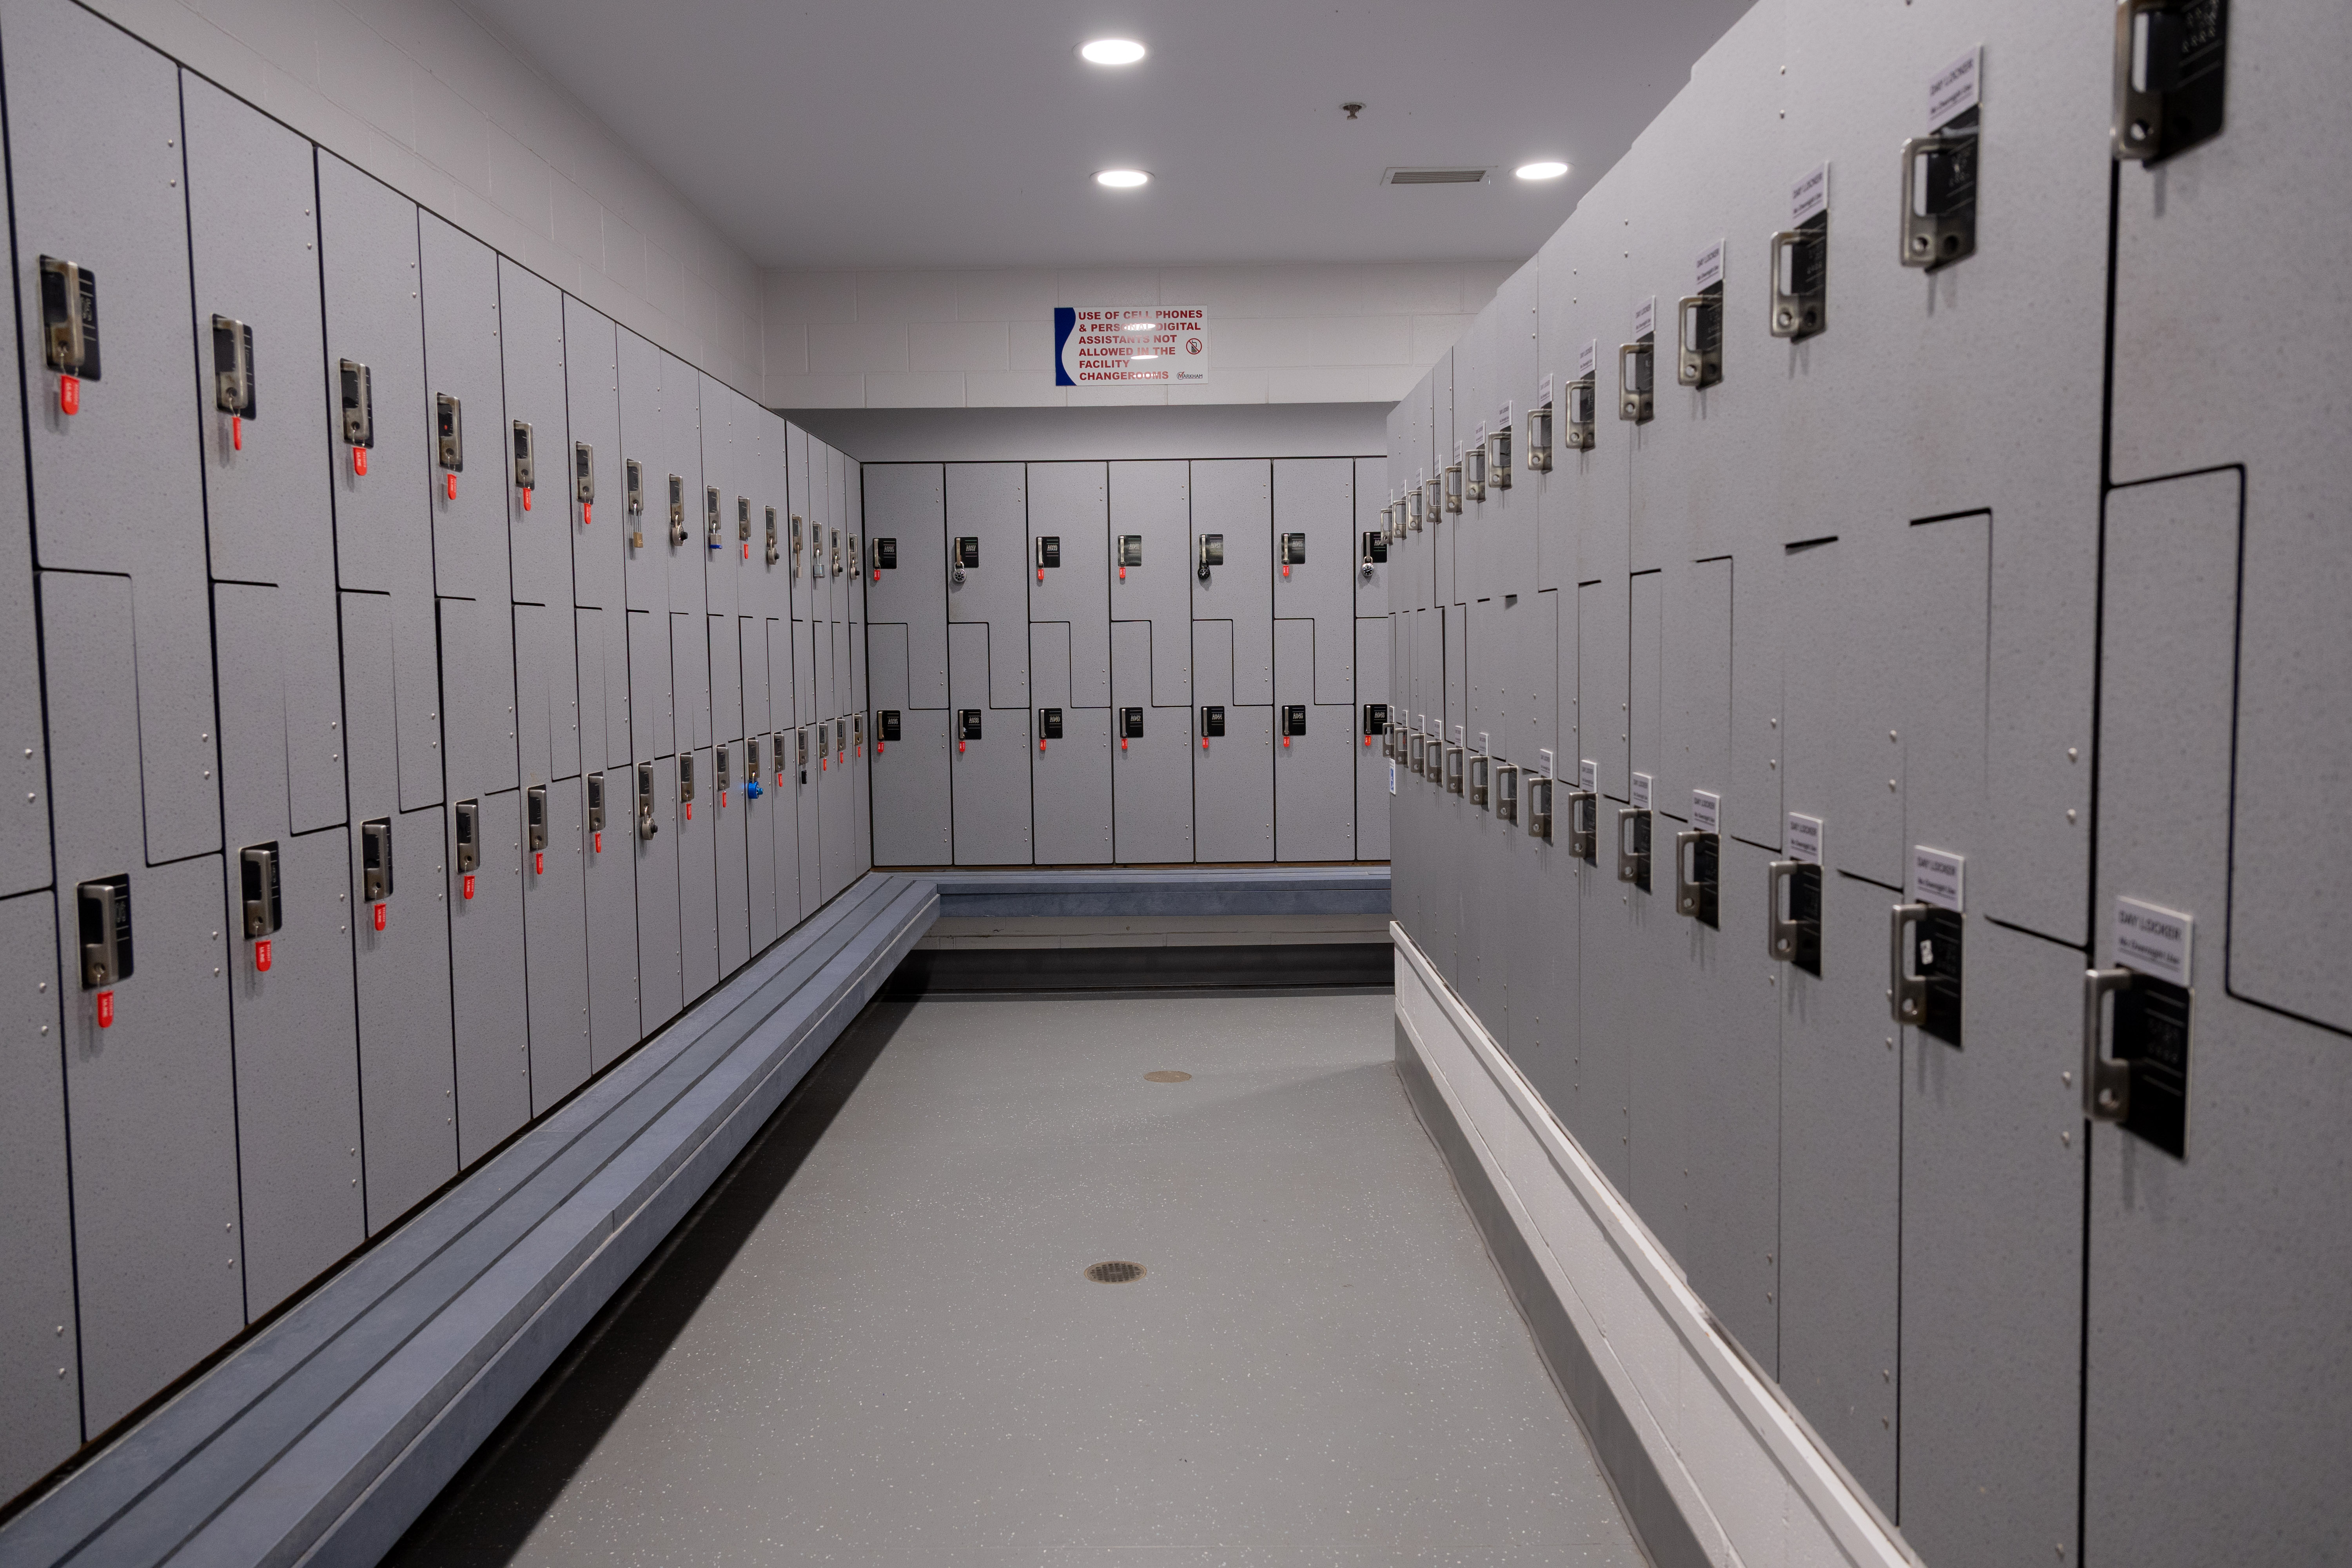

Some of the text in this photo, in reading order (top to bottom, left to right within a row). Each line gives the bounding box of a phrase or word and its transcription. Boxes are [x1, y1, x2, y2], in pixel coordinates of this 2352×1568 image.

[1079, 310, 1203, 320] USE OF CELL PHONES
[1091, 323, 1152, 332] PERSONAL
[1156, 322, 1201, 331] DIGITAL
[1079, 335, 1150, 344] ASSISTANTS
[1079, 348, 1133, 356] ALLOWED
[1079, 359, 1130, 368] FACILITY
[1080, 371, 1169, 380] CHANGEROOMS
[1178, 372, 1203, 380] MARKHAM
[2119, 909, 2182, 941] DAY LOCKER
